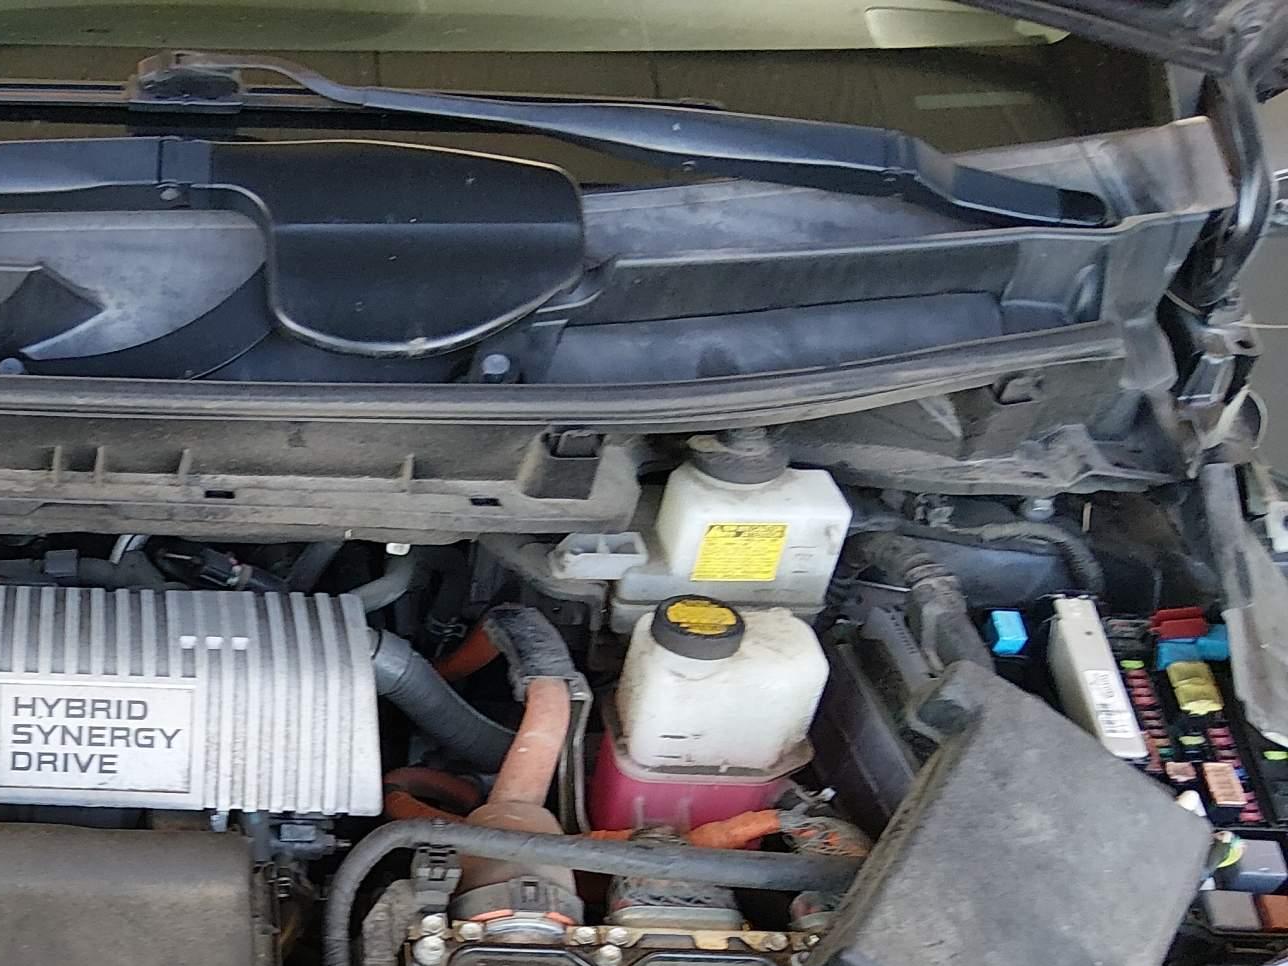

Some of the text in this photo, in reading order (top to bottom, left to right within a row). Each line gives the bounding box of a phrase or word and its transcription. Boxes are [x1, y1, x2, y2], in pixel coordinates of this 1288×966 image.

[13, 696, 149, 721] HYBRID
[11, 723, 184, 749] SYNERGY
[10, 751, 119, 774] DRIVE
